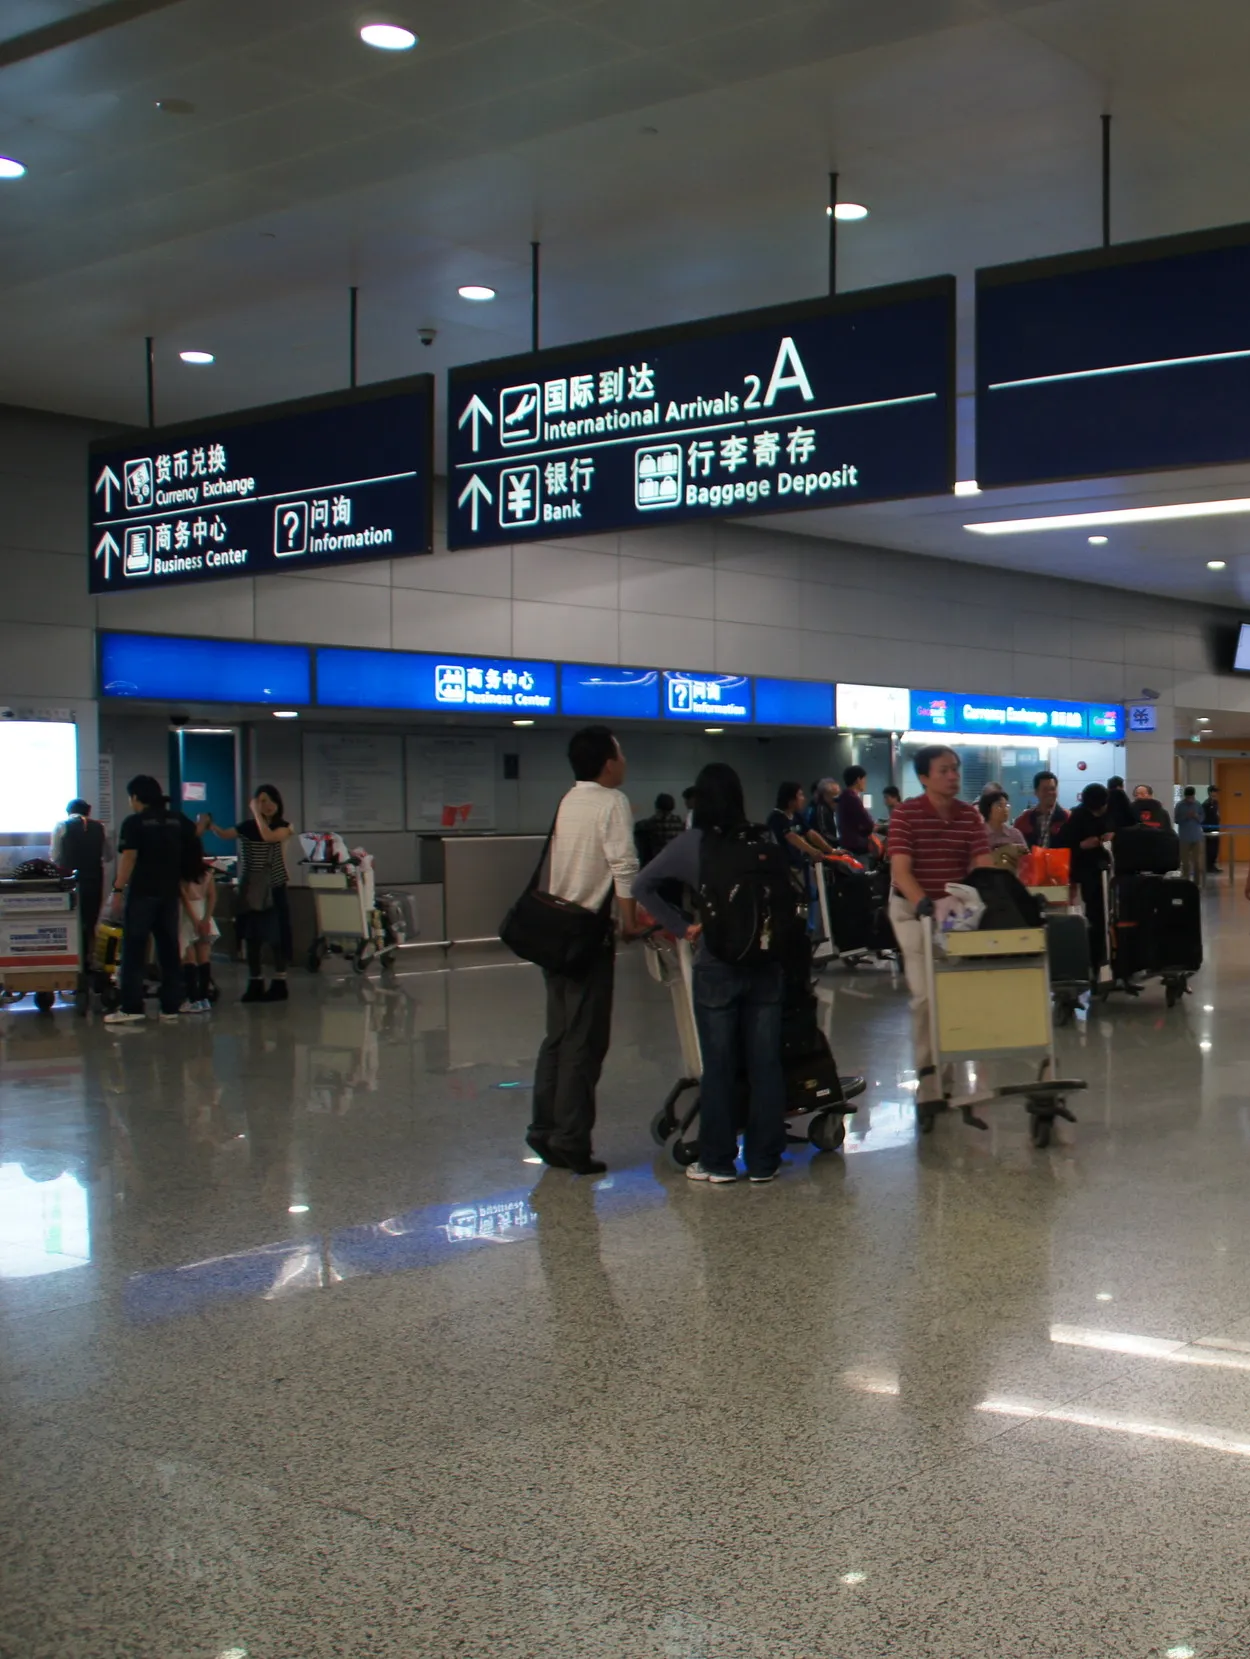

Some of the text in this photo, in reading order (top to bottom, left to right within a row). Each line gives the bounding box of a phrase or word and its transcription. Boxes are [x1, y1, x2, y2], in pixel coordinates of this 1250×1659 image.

[543, 362, 656, 416] 国际到达
[543, 401, 660, 442] International
[664, 390, 739, 423] Arrivals
[154, 443, 226, 485] 货币兑换
[686, 425, 816, 478] 行李寄存
[155, 476, 255, 506] Currency Exchange
[543, 457, 595, 496] 银行
[685, 463, 858, 507] Baggage Deposit
[310, 494, 351, 530] 问询
[543, 498, 582, 522] Bank
[154, 514, 227, 552] 商务中心
[309, 526, 393, 553] Information
[153, 548, 248, 575] Business Center
[466, 691, 551, 706] Business Center
